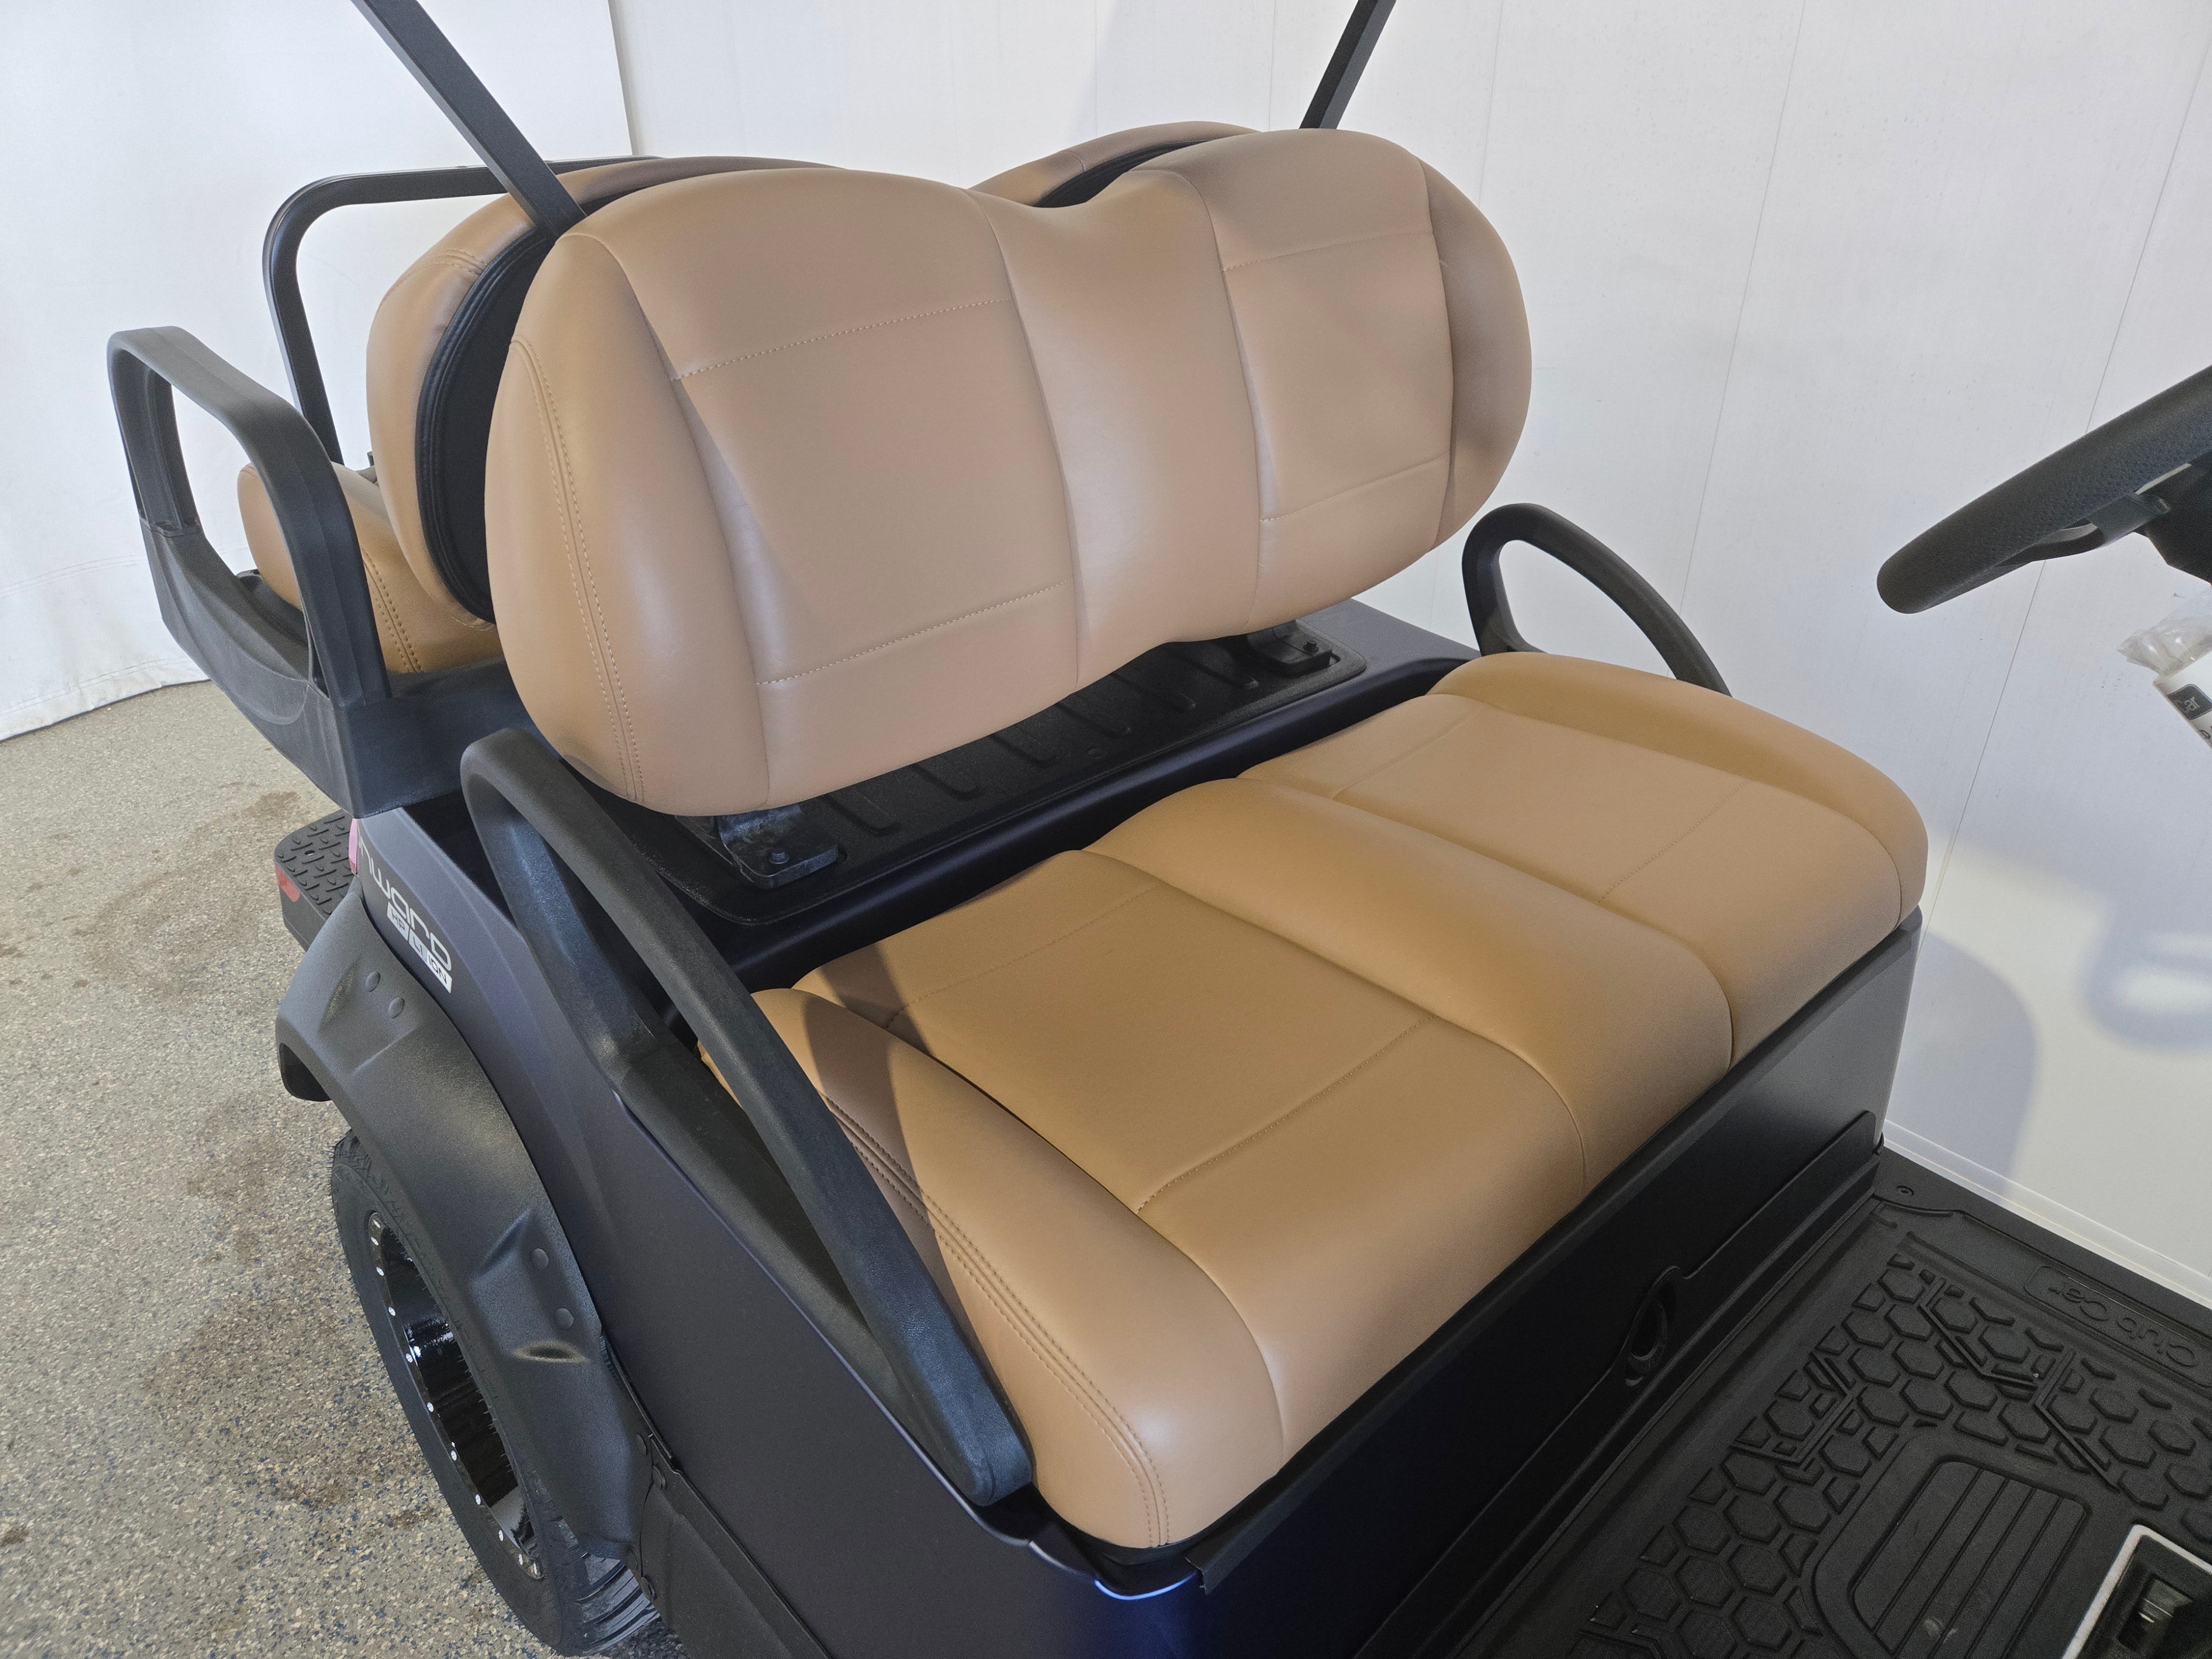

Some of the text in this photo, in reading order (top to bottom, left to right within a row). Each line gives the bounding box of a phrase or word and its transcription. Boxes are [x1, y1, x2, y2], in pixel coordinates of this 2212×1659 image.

[391, 912, 405, 930] HP
[2047, 1286, 2199, 1368] Club Car
